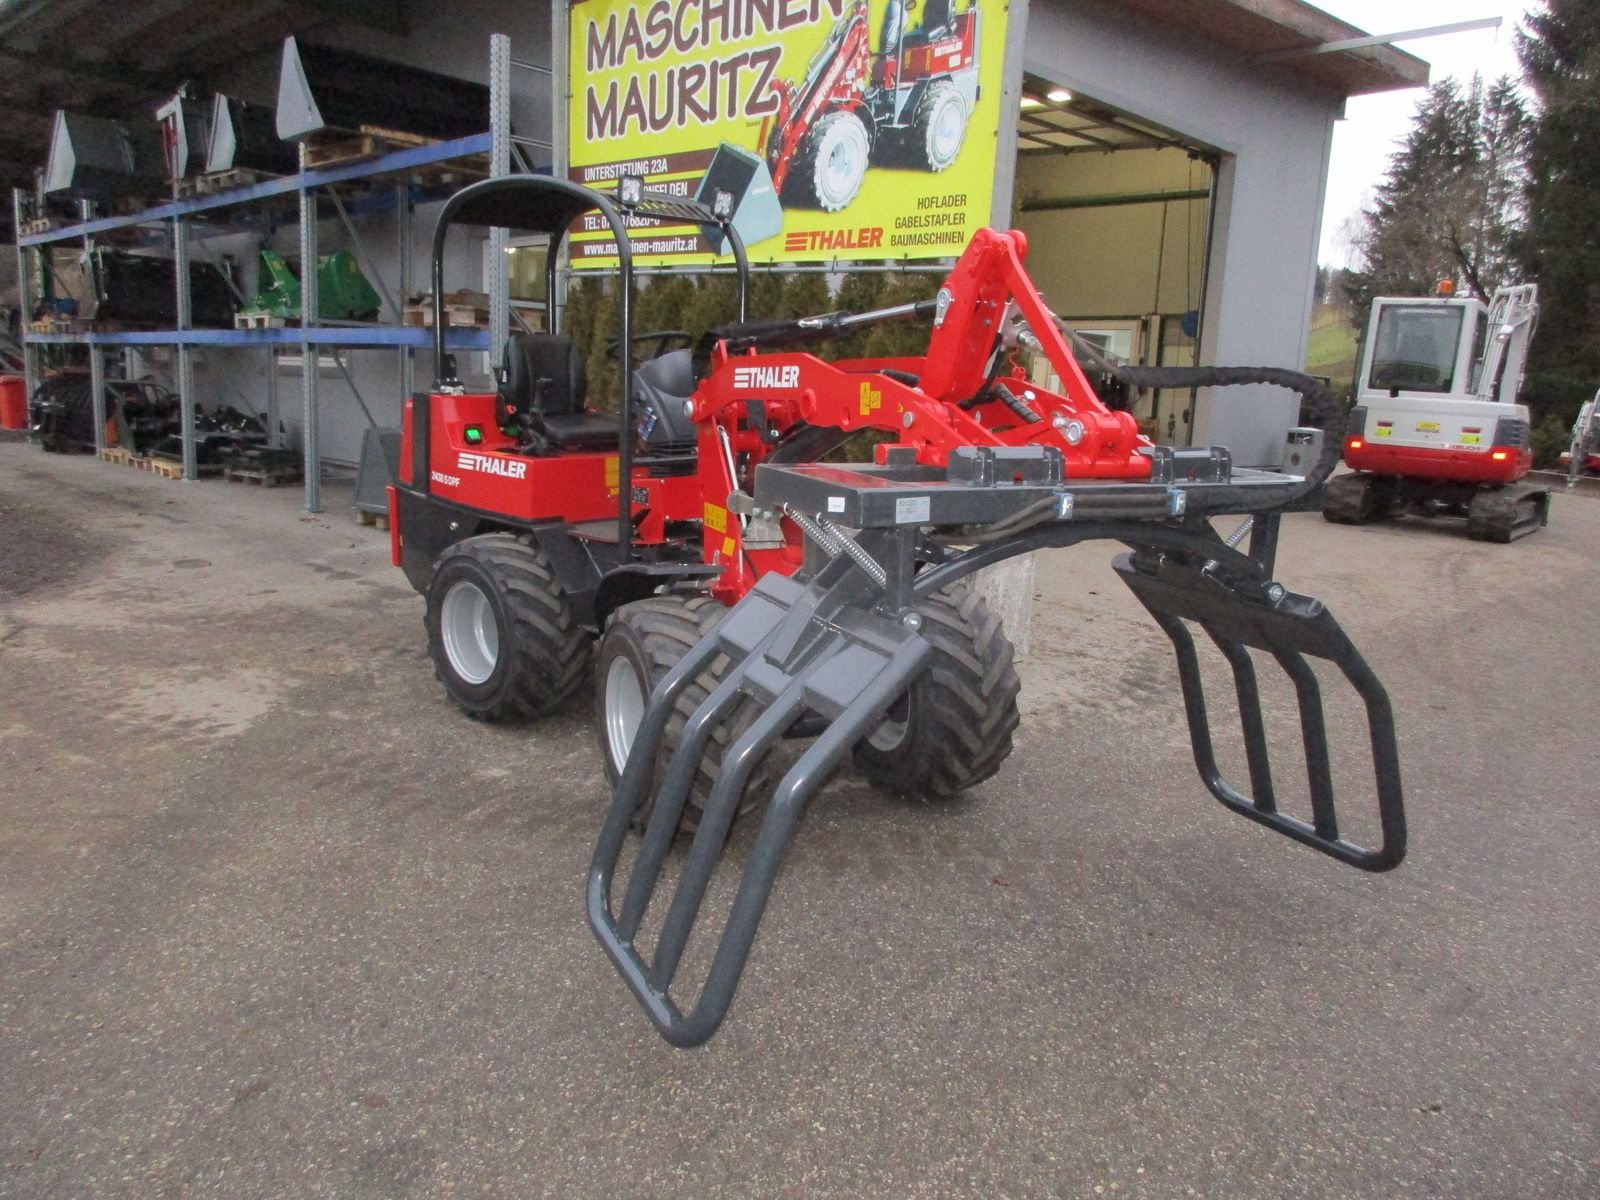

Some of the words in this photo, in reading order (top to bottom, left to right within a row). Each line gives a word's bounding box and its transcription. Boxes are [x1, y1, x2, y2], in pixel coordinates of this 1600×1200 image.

[586, 45, 782, 140] MAURITZ
[584, 161, 650, 181] UNTERSTIFTUNG
[651, 158, 668, 173] 23A
[917, 194, 967, 210] HOFLADER
[584, 216, 600, 230] TEL:
[894, 213, 966, 229] GABELSTAPLER
[584, 237, 697, 255] www.mainen-mauritz.at
[807, 227, 884, 251] THALER
[890, 231, 965, 247] BAUMASCHINEN
[750, 365, 800, 388] THALER
[473, 455, 527, 479] THALER
